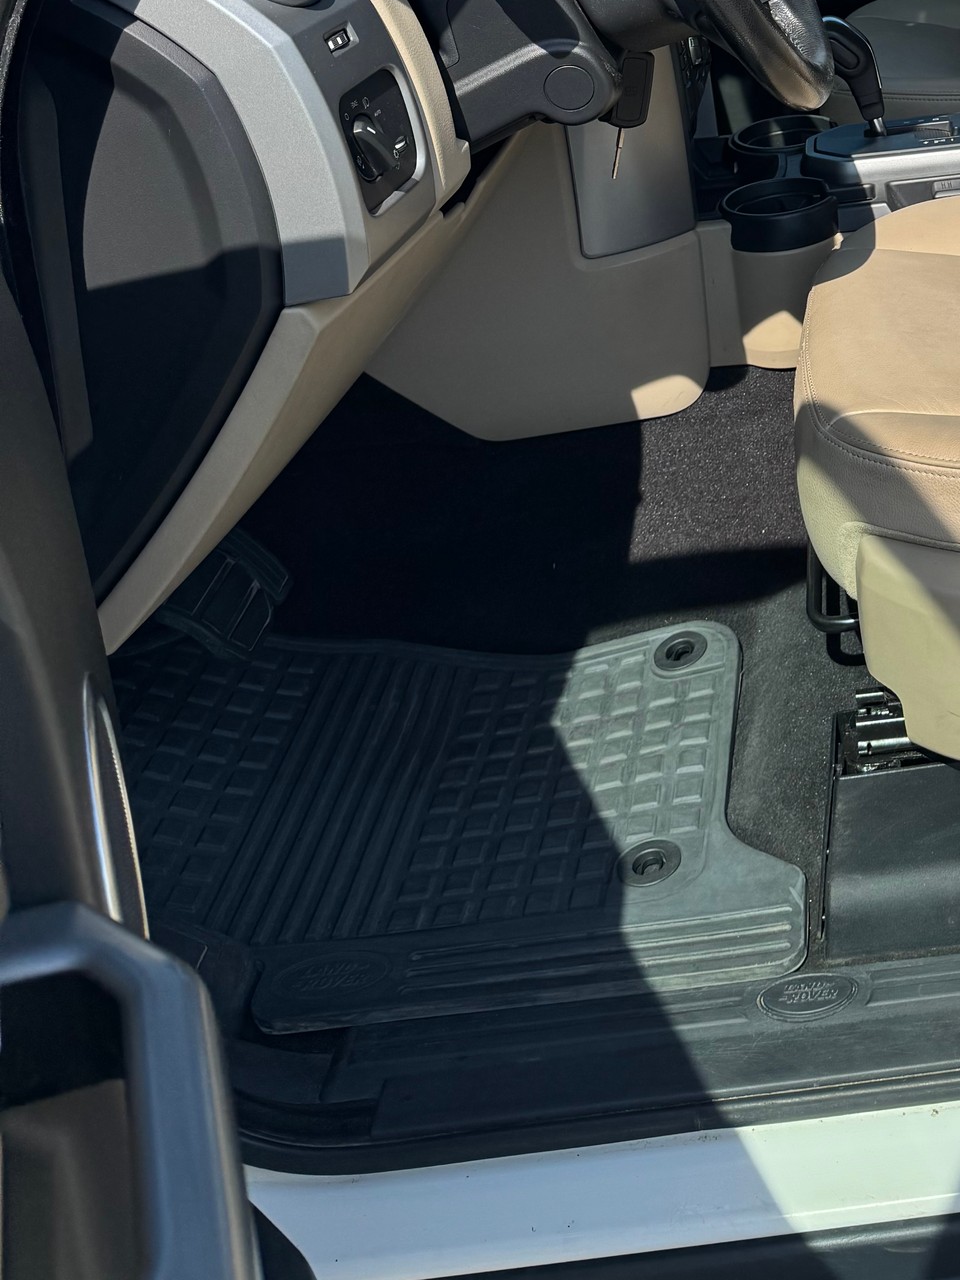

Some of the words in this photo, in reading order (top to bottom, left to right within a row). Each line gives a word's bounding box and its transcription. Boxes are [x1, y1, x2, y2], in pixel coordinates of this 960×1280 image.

[301, 961, 359, 979] LAND
[300, 972, 370, 993] ROVER
[783, 981, 828, 994] LAND
[786, 988, 839, 1004] ROVER
